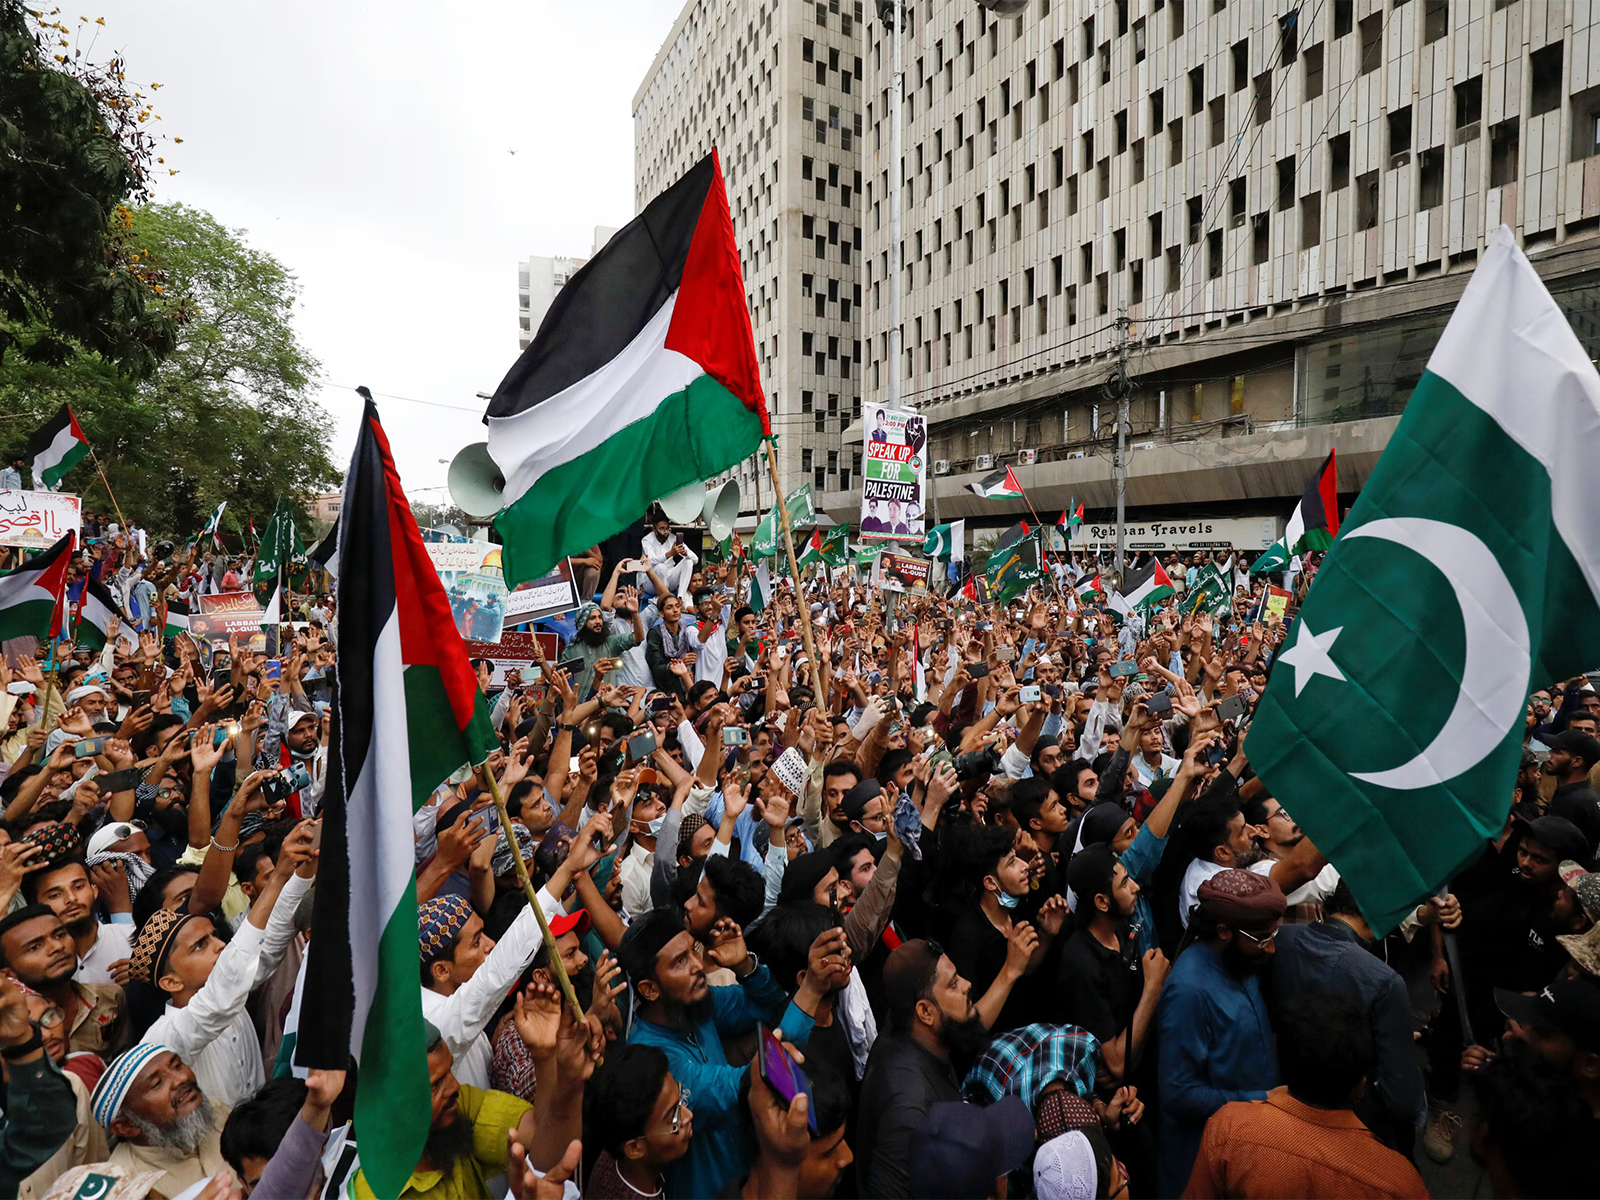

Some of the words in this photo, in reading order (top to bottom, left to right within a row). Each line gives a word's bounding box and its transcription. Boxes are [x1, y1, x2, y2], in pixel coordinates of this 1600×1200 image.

[868, 442, 895, 460] SPEAK
[898, 446, 910, 461] UP
[881, 461, 900, 480] FOR
[865, 482, 914, 500] PALESTINE
[1091, 526, 1145, 539] Rehan
[1151, 523, 1212, 536] Travels
[900, 569, 926, 577] AL-QUDS
[901, 563, 927, 572] LABBAIK
[1529, 928, 1544, 946] TLP
